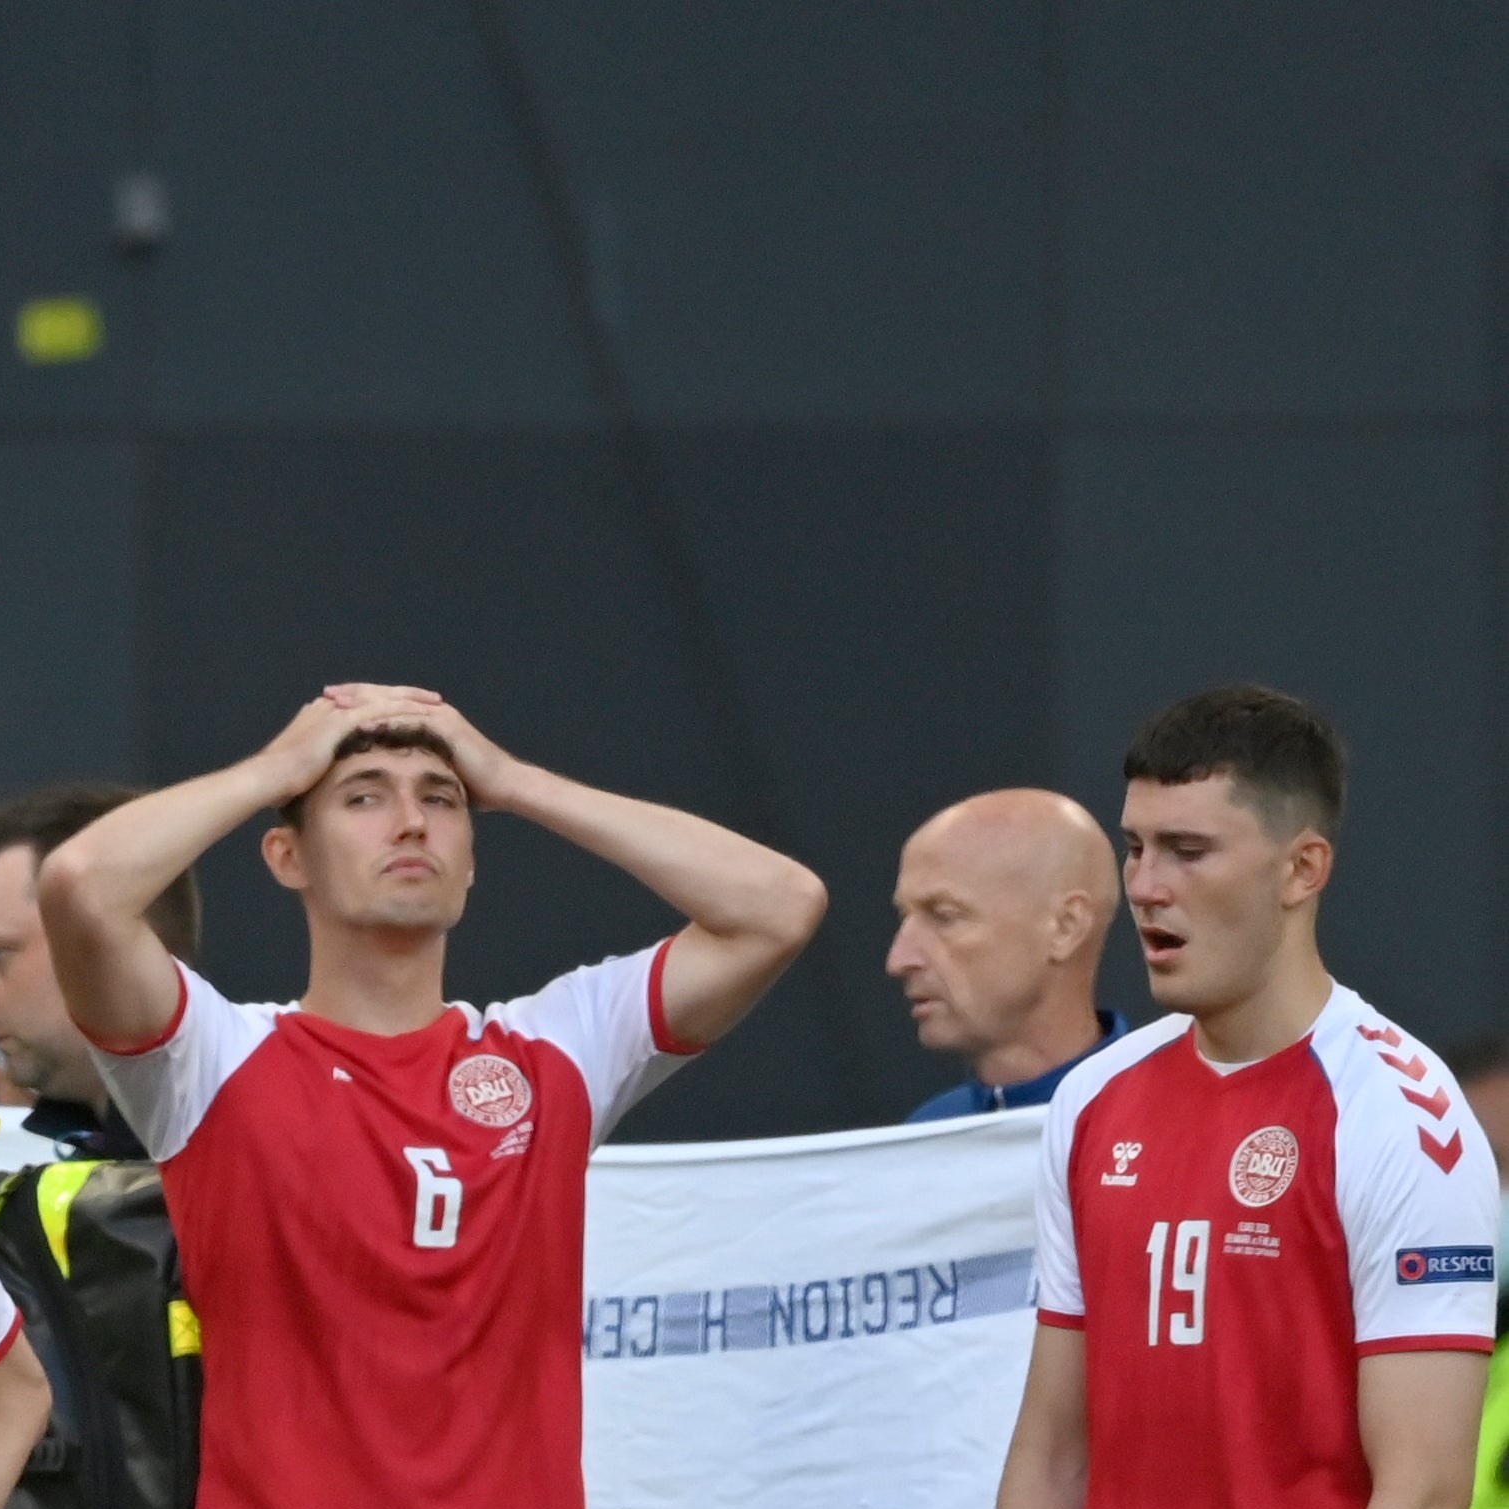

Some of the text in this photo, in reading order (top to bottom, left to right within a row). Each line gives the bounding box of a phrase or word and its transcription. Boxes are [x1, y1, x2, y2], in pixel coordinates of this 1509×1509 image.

[403, 1146, 463, 1249] 6
[1246, 1152, 1287, 1178] DBU
[768, 1261, 959, 1348] REGION
[1145, 1219, 1211, 1347] 19
[1427, 1255, 1494, 1273] RESPECT
